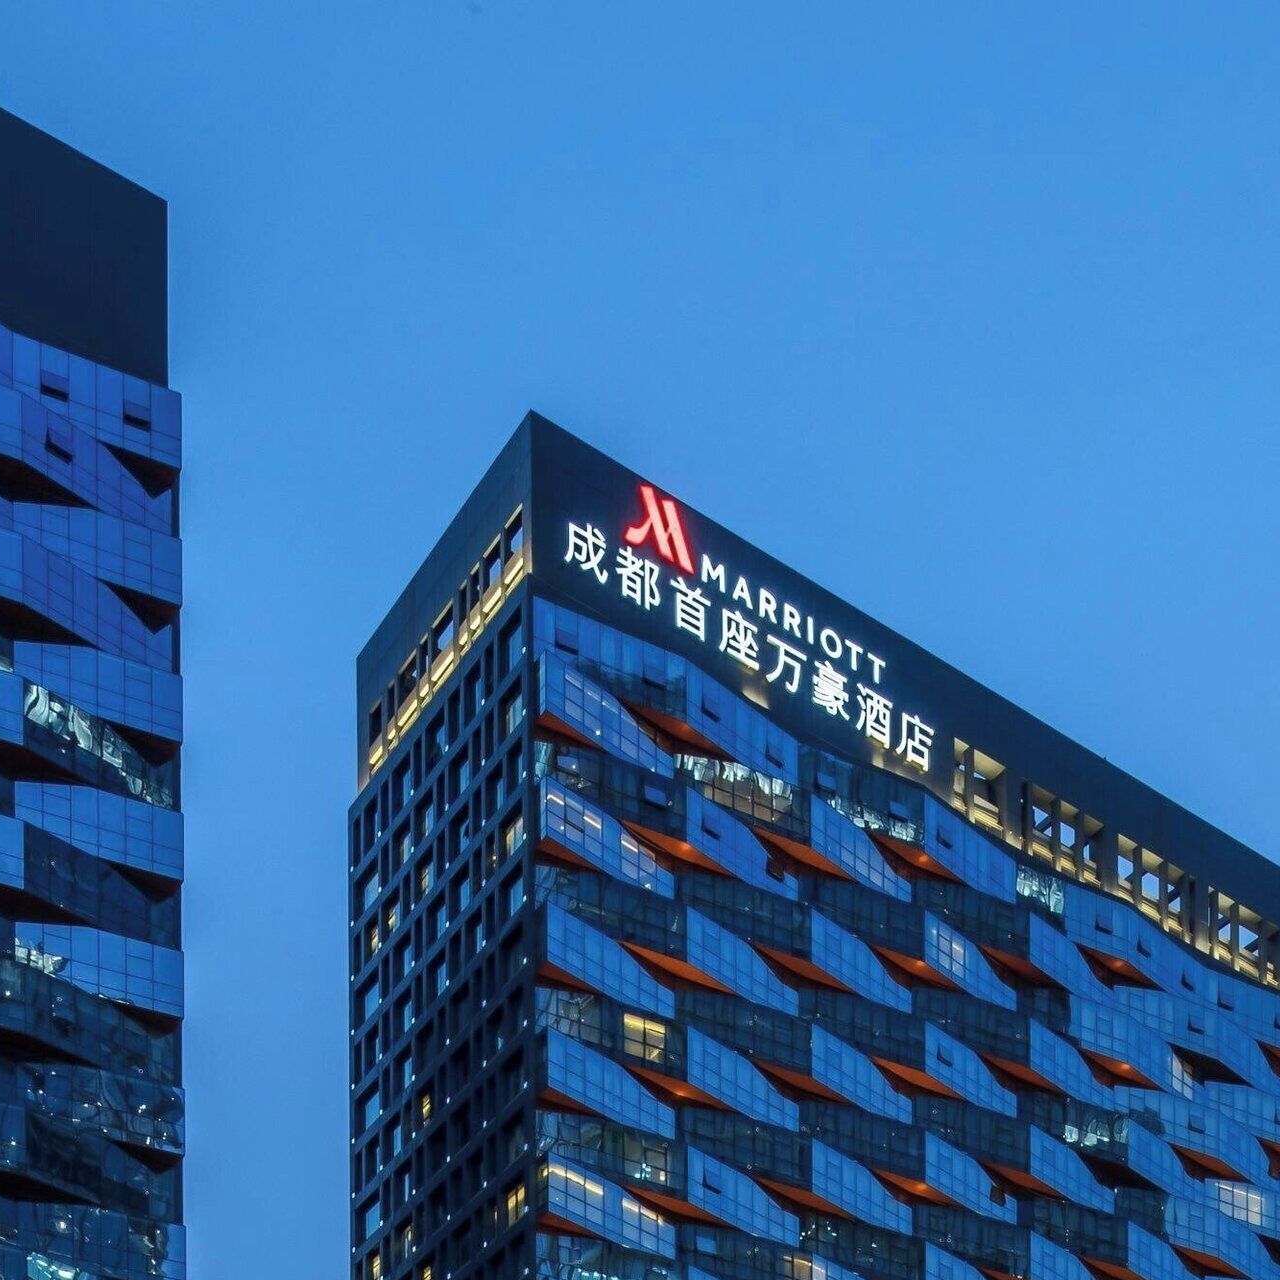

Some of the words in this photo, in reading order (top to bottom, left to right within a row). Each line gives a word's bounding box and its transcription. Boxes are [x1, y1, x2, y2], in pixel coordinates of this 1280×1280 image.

[563, 521, 935, 773] 成都首座万豪酒店
[700, 553, 886, 684] MARRIOTT
